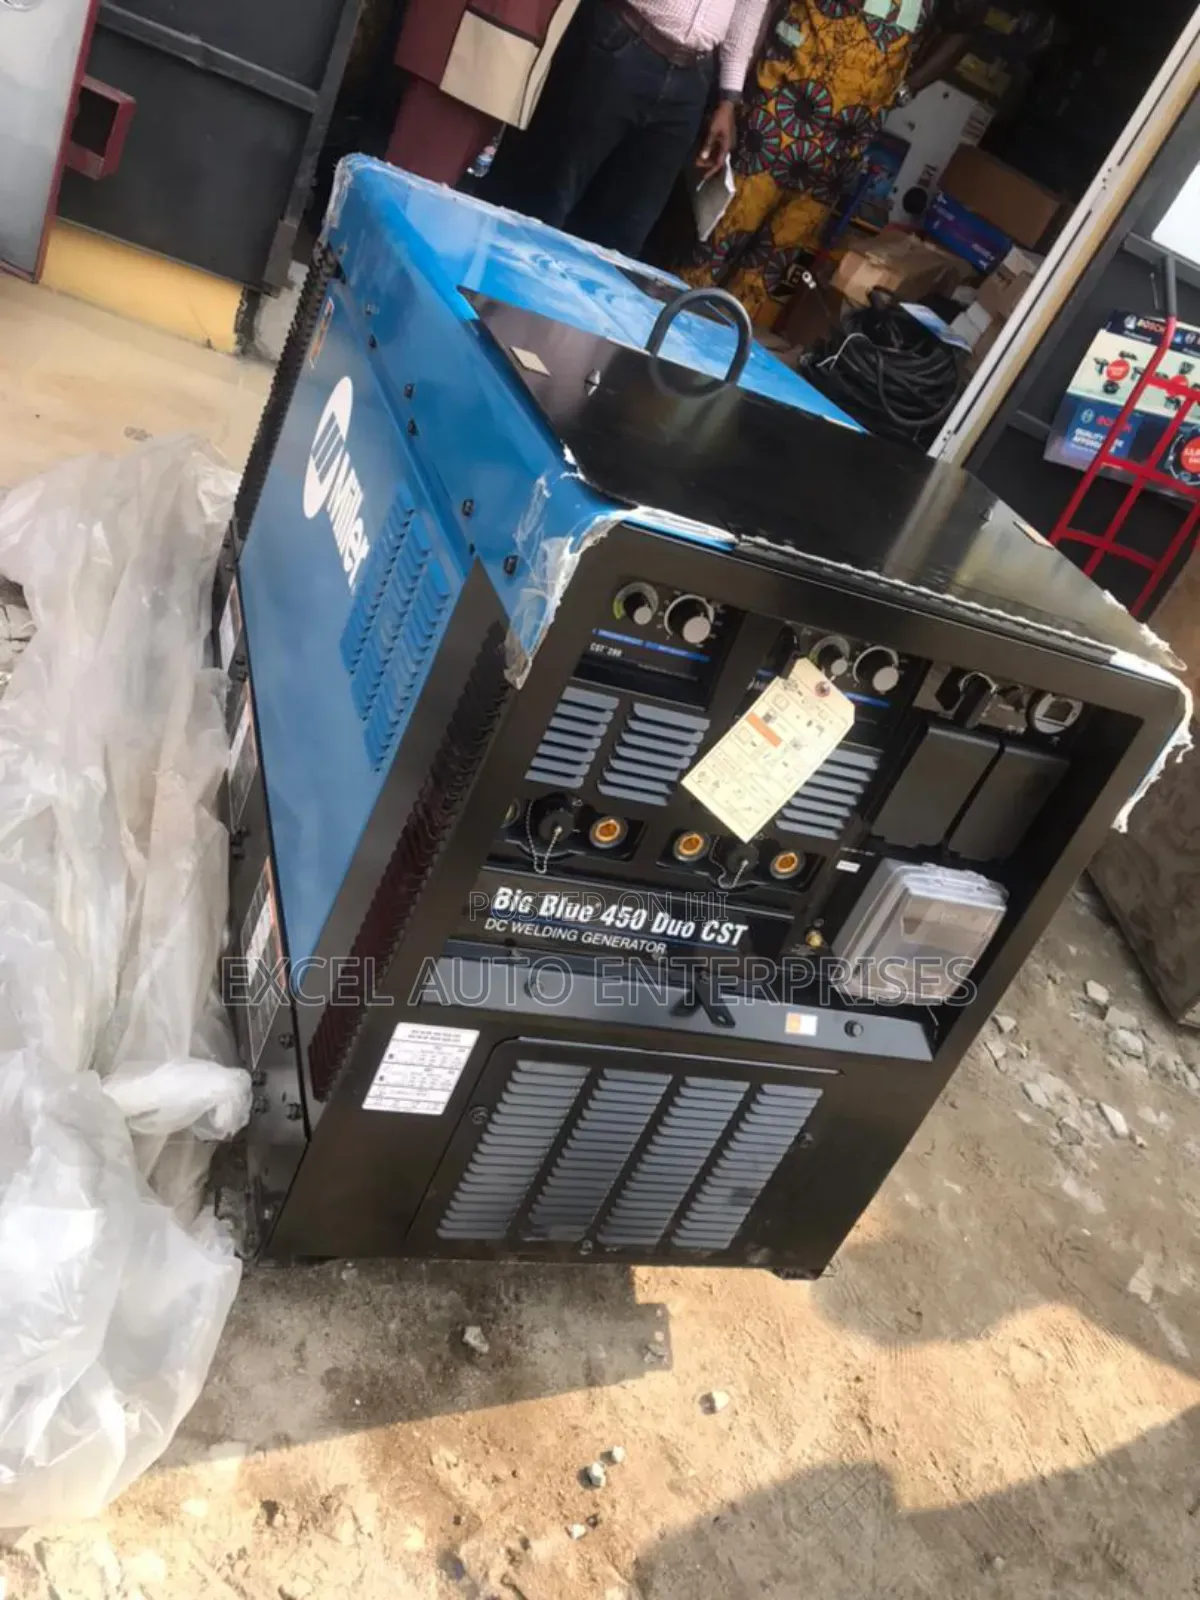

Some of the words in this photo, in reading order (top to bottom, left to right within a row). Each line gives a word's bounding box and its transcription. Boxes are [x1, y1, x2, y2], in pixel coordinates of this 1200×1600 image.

[327, 451, 370, 589] Miller
[484, 917, 509, 931] DC
[511, 920, 579, 941] WELDING
[581, 931, 667, 954] GENERATOR
[600, 904, 648, 930] 450
[651, 911, 696, 938] Duo
[701, 920, 749, 946] CST
